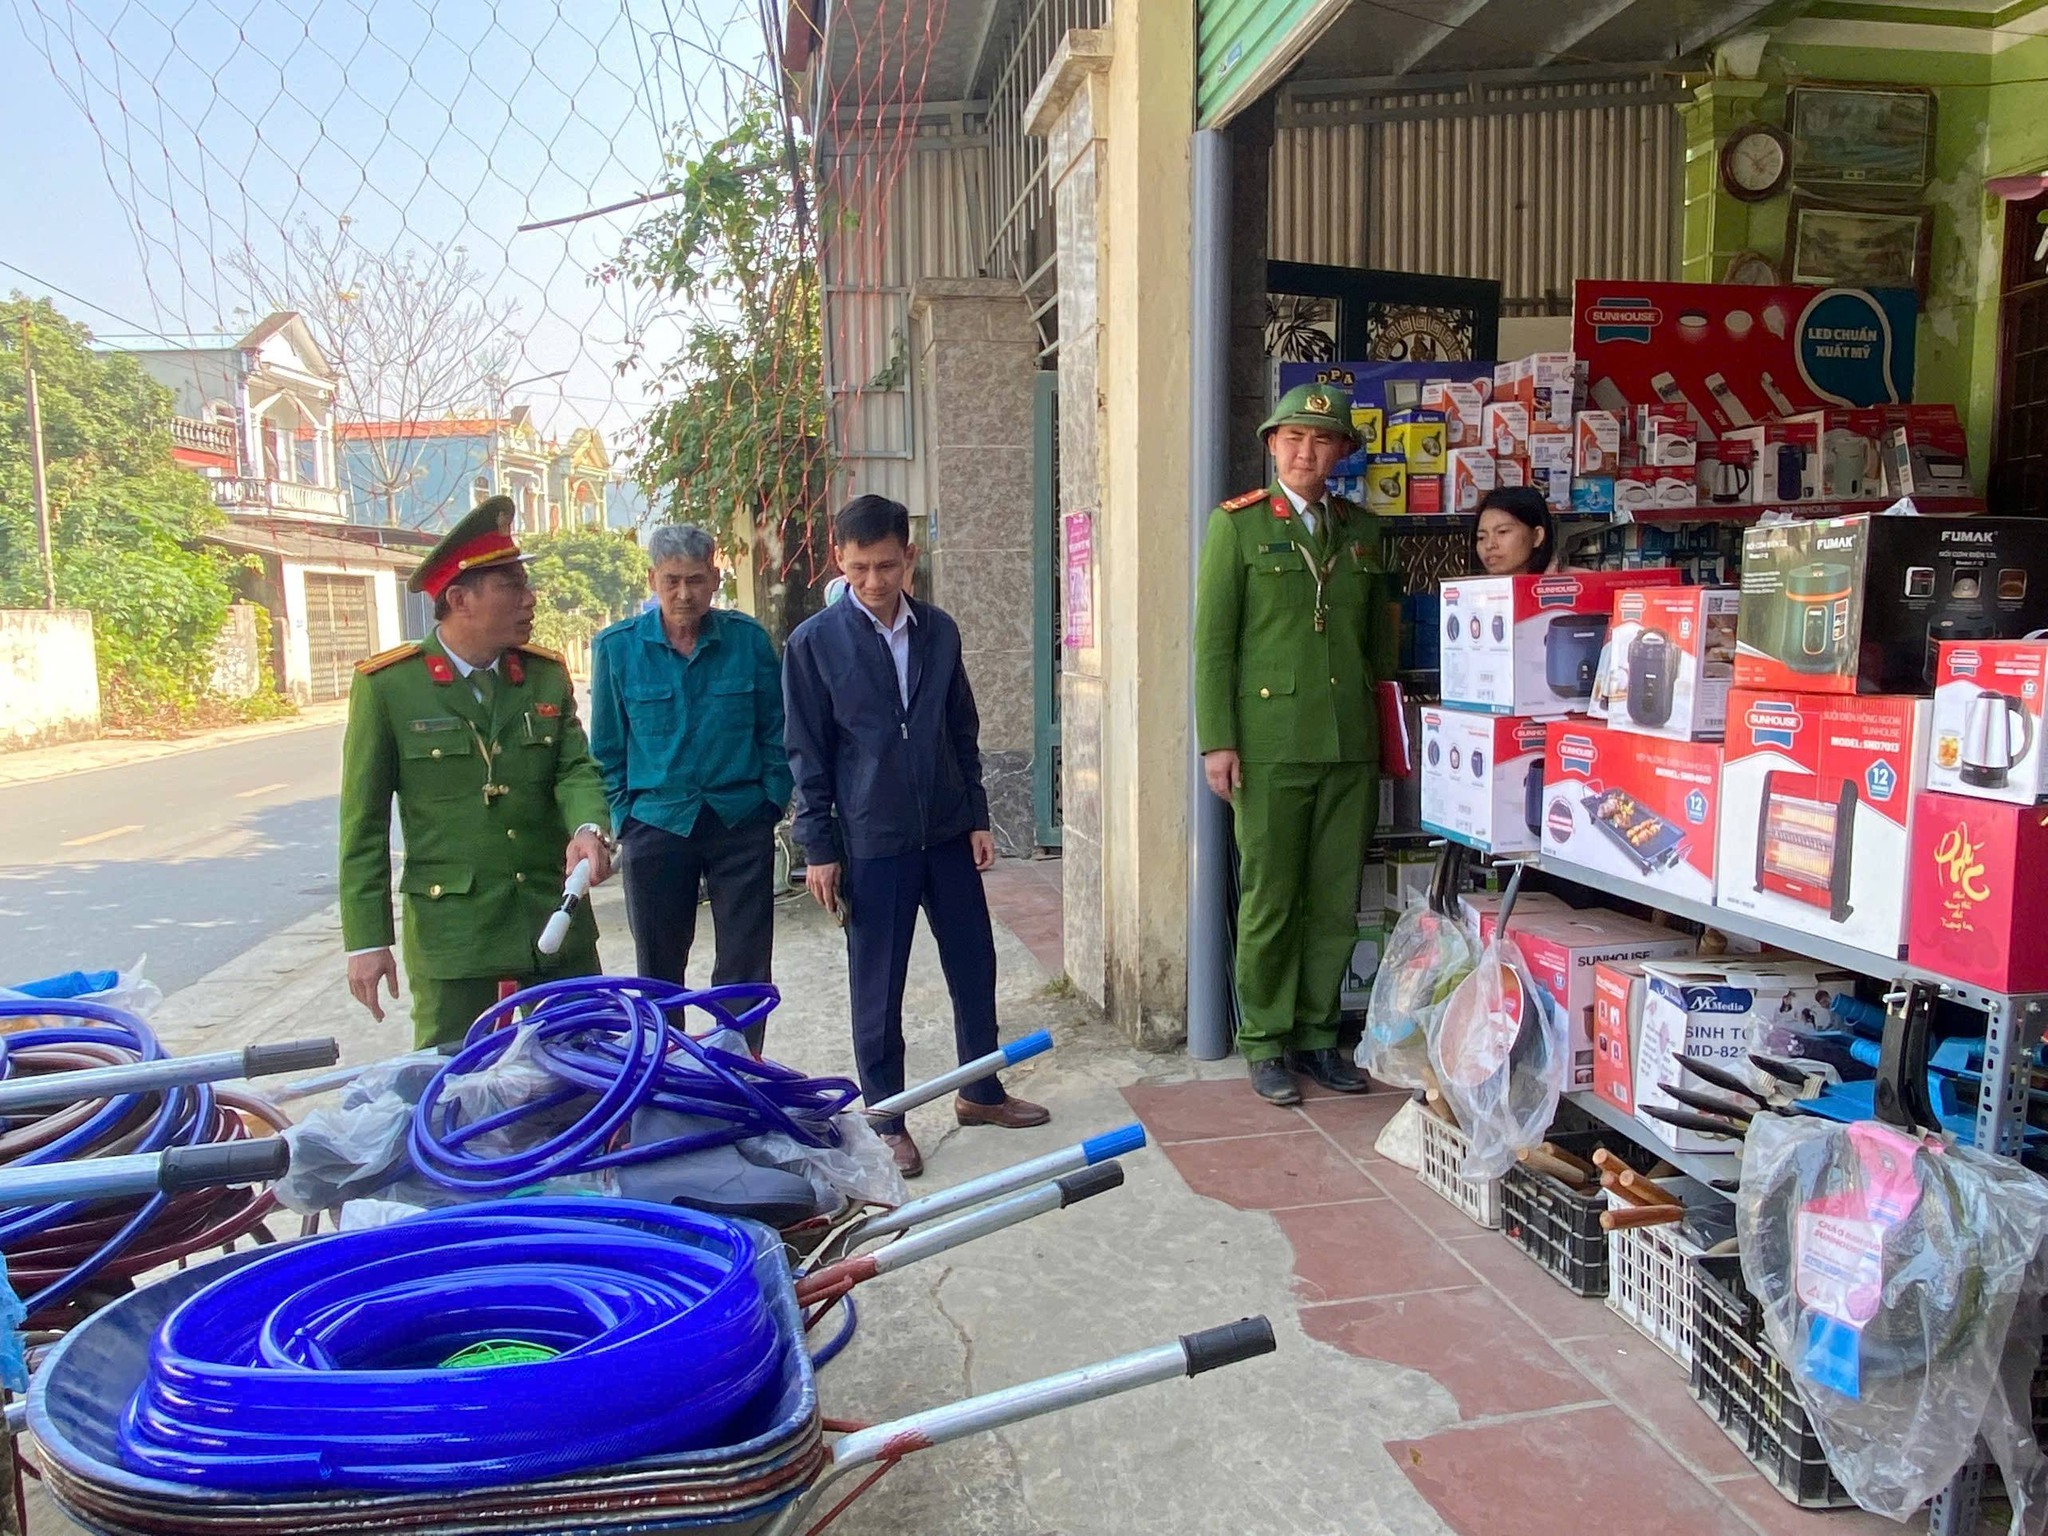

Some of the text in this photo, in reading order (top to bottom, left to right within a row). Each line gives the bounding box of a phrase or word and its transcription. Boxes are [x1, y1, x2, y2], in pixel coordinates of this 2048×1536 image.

[1592, 310, 1657, 323] SUNHOUSE
[1808, 327, 1832, 340] LED
[1816, 342, 1871, 359] XUẤT MỸ
[1317, 370, 1353, 384] DPA
[1816, 536, 1854, 550] FUMAK
[1941, 530, 1993, 542] FUMAK
[1536, 585, 1578, 594] SUNHOUSE
[1749, 714, 1798, 728] SUNHOUSE
[1517, 729, 1546, 737] SUNHO
[1831, 736, 1863, 749] MODEL:
[1561, 745, 1593, 759] SUNHOUSE
[1872, 767, 1889, 785] 12
[1690, 795, 1702, 811] 12
[1712, 1001, 1744, 1012] Media
[1685, 1025, 1725, 1040] SINH
